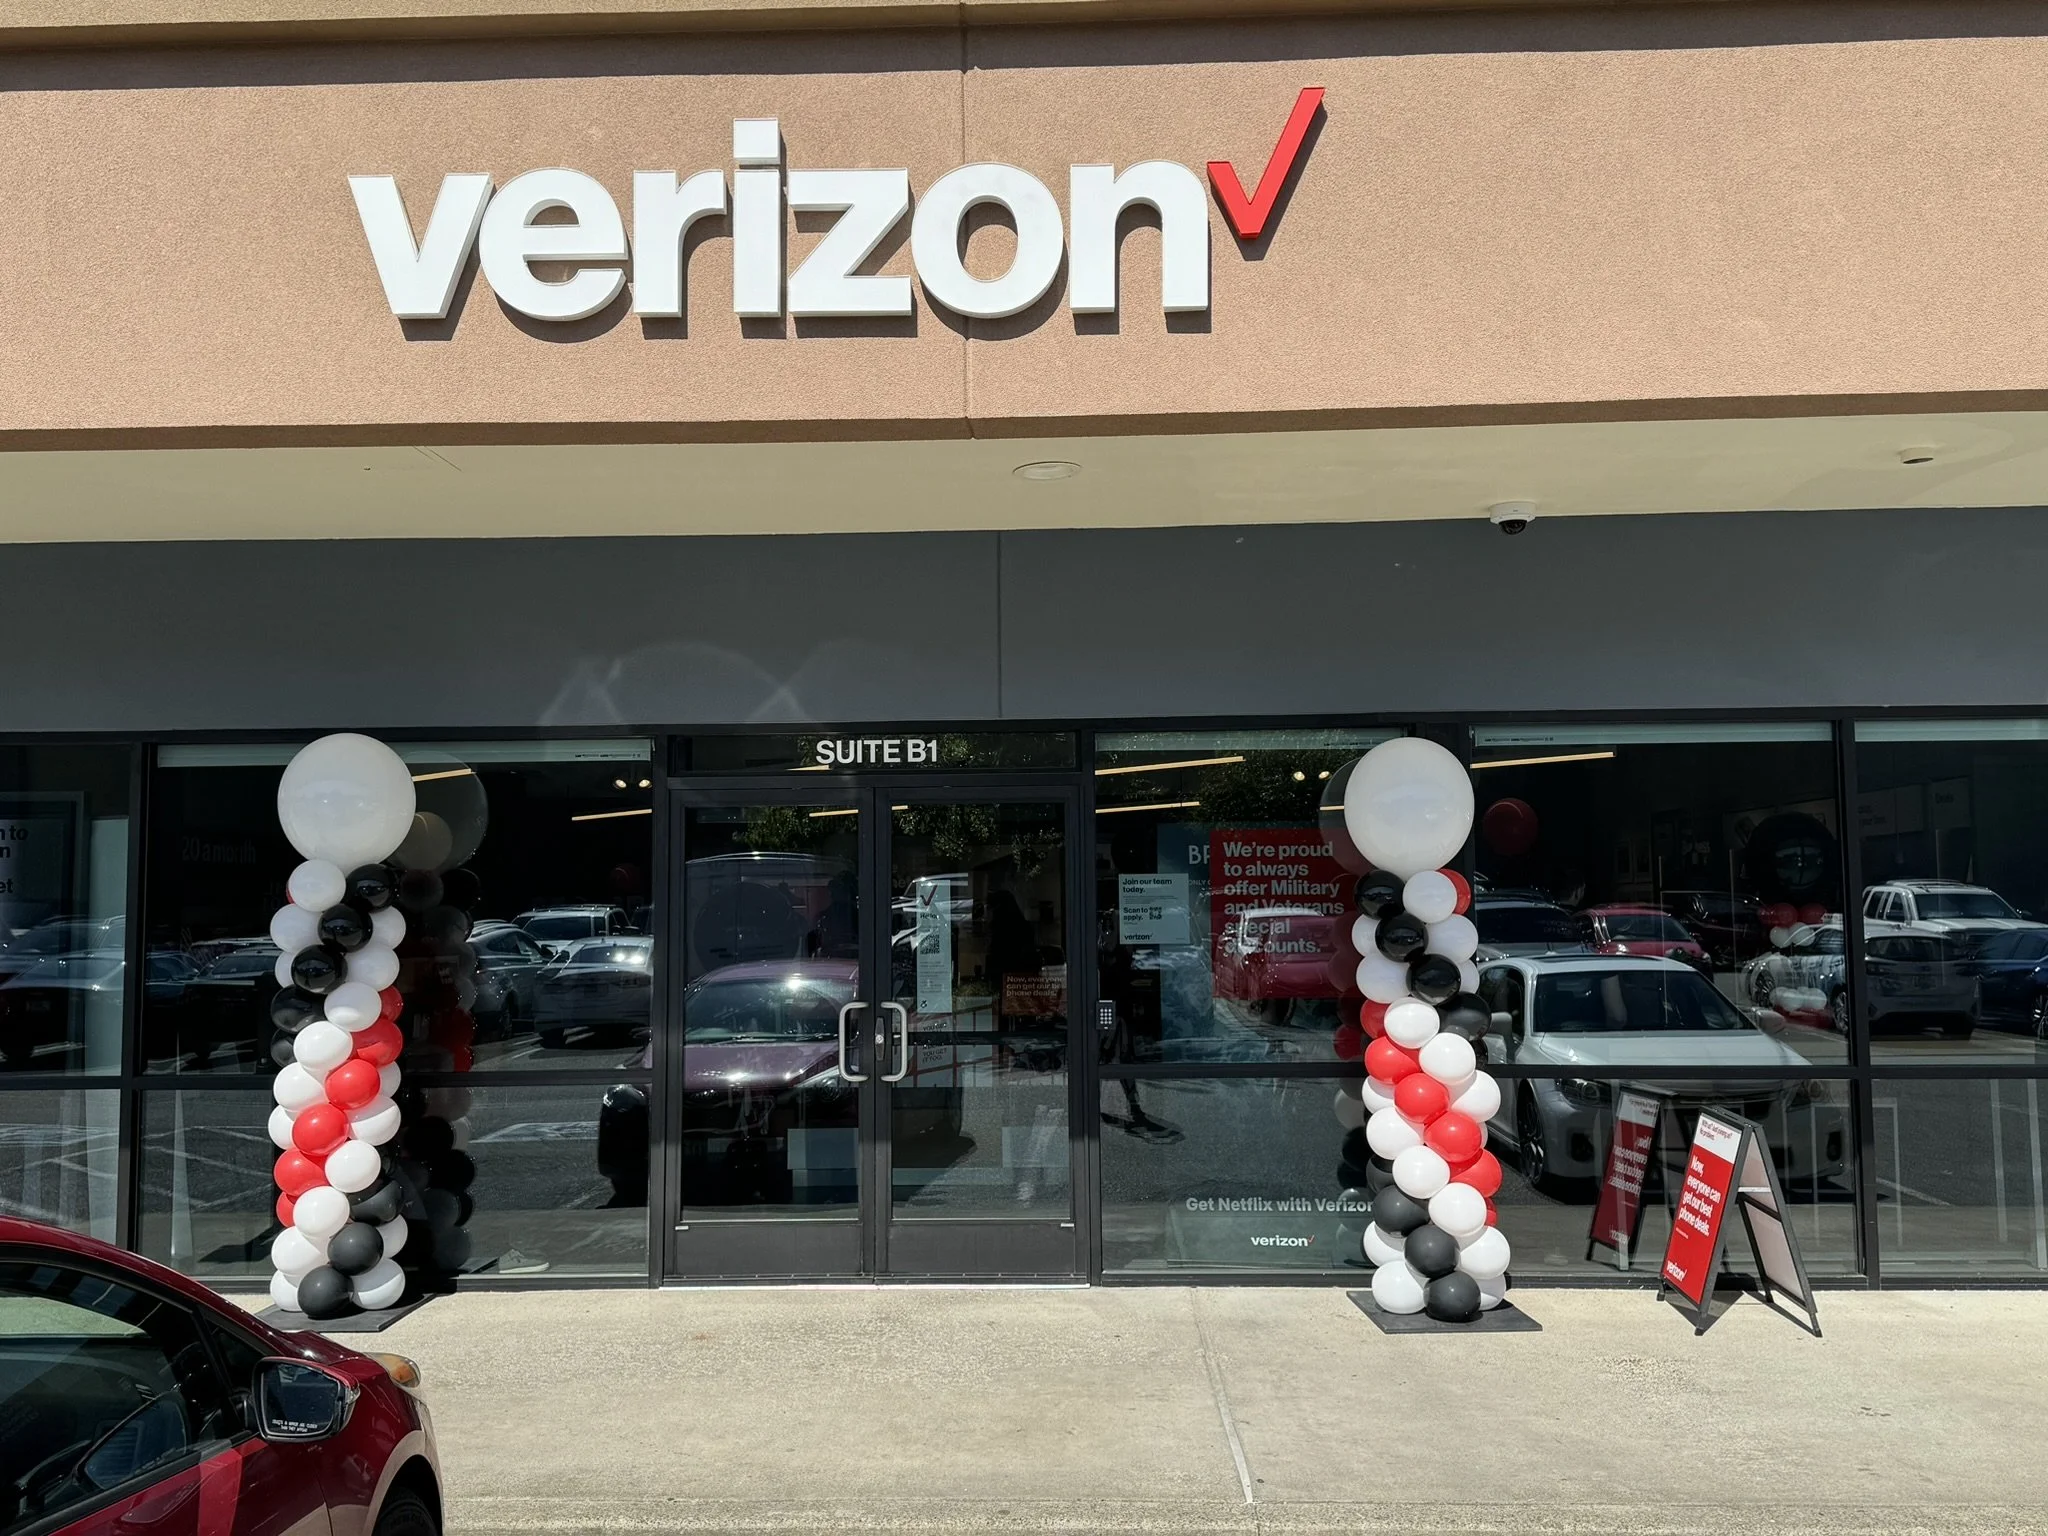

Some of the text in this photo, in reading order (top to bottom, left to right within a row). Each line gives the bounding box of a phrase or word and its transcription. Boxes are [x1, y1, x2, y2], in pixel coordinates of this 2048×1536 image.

[348, 118, 1208, 320] verizon
[816, 739, 937, 764] SUITE B1
[9, 825, 29, 841] to
[1278, 841, 1334, 860] proud
[1223, 861, 1309, 879] to always
[1224, 879, 1341, 898] offer Military
[1224, 899, 1258, 915] and
[1124, 933, 1151, 941] verizon
[1691, 1155, 1704, 1177] Now,
[1687, 1174, 1721, 1204] everyone can
[1186, 1198, 1214, 1212] Get
[1218, 1197, 1273, 1212] Netflix
[1276, 1197, 1312, 1212] with
[1683, 1191, 1713, 1219] get our best
[1678, 1205, 1696, 1226] phone
[1251, 1234, 1308, 1247] verizon
[1666, 1260, 1684, 1282] verizon
